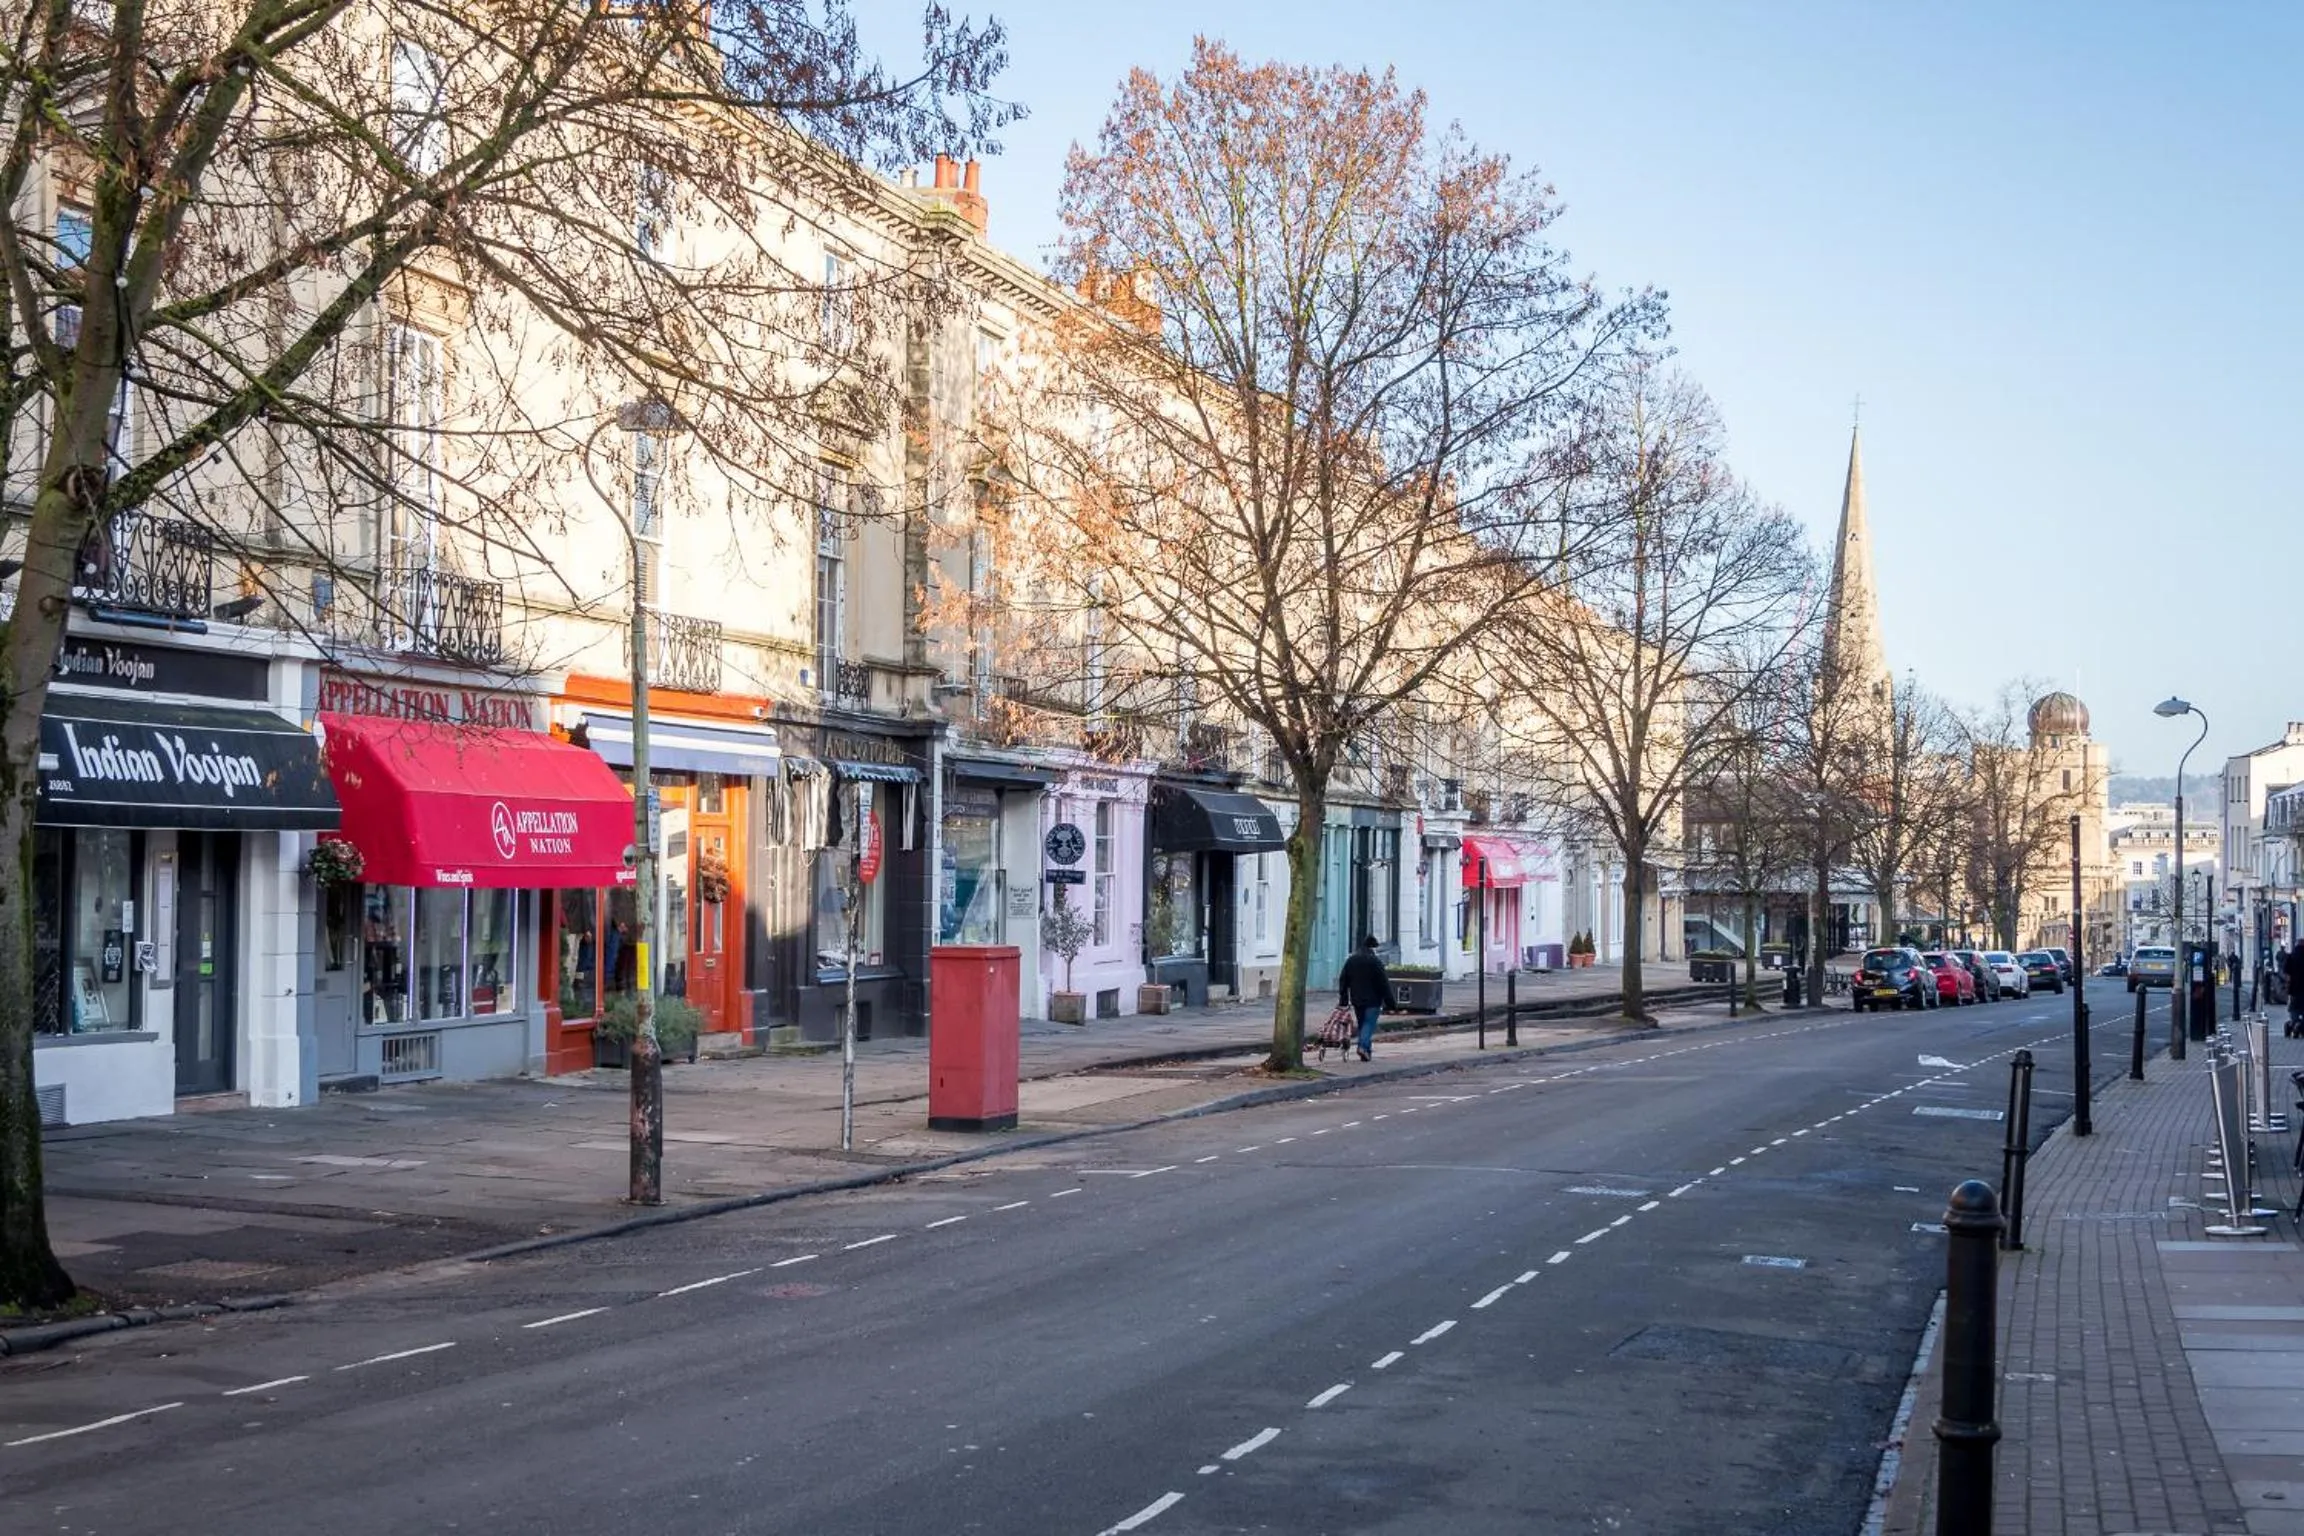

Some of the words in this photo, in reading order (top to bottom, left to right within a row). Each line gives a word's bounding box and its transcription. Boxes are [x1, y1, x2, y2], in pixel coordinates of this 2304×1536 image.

[58, 646, 104, 674] Indian
[105, 646, 155, 686] Voojan
[63, 723, 164, 783] Indian
[155, 731, 262, 797] Voojan
[516, 811, 579, 834] APPELLATION
[529, 838, 572, 854] NATION
